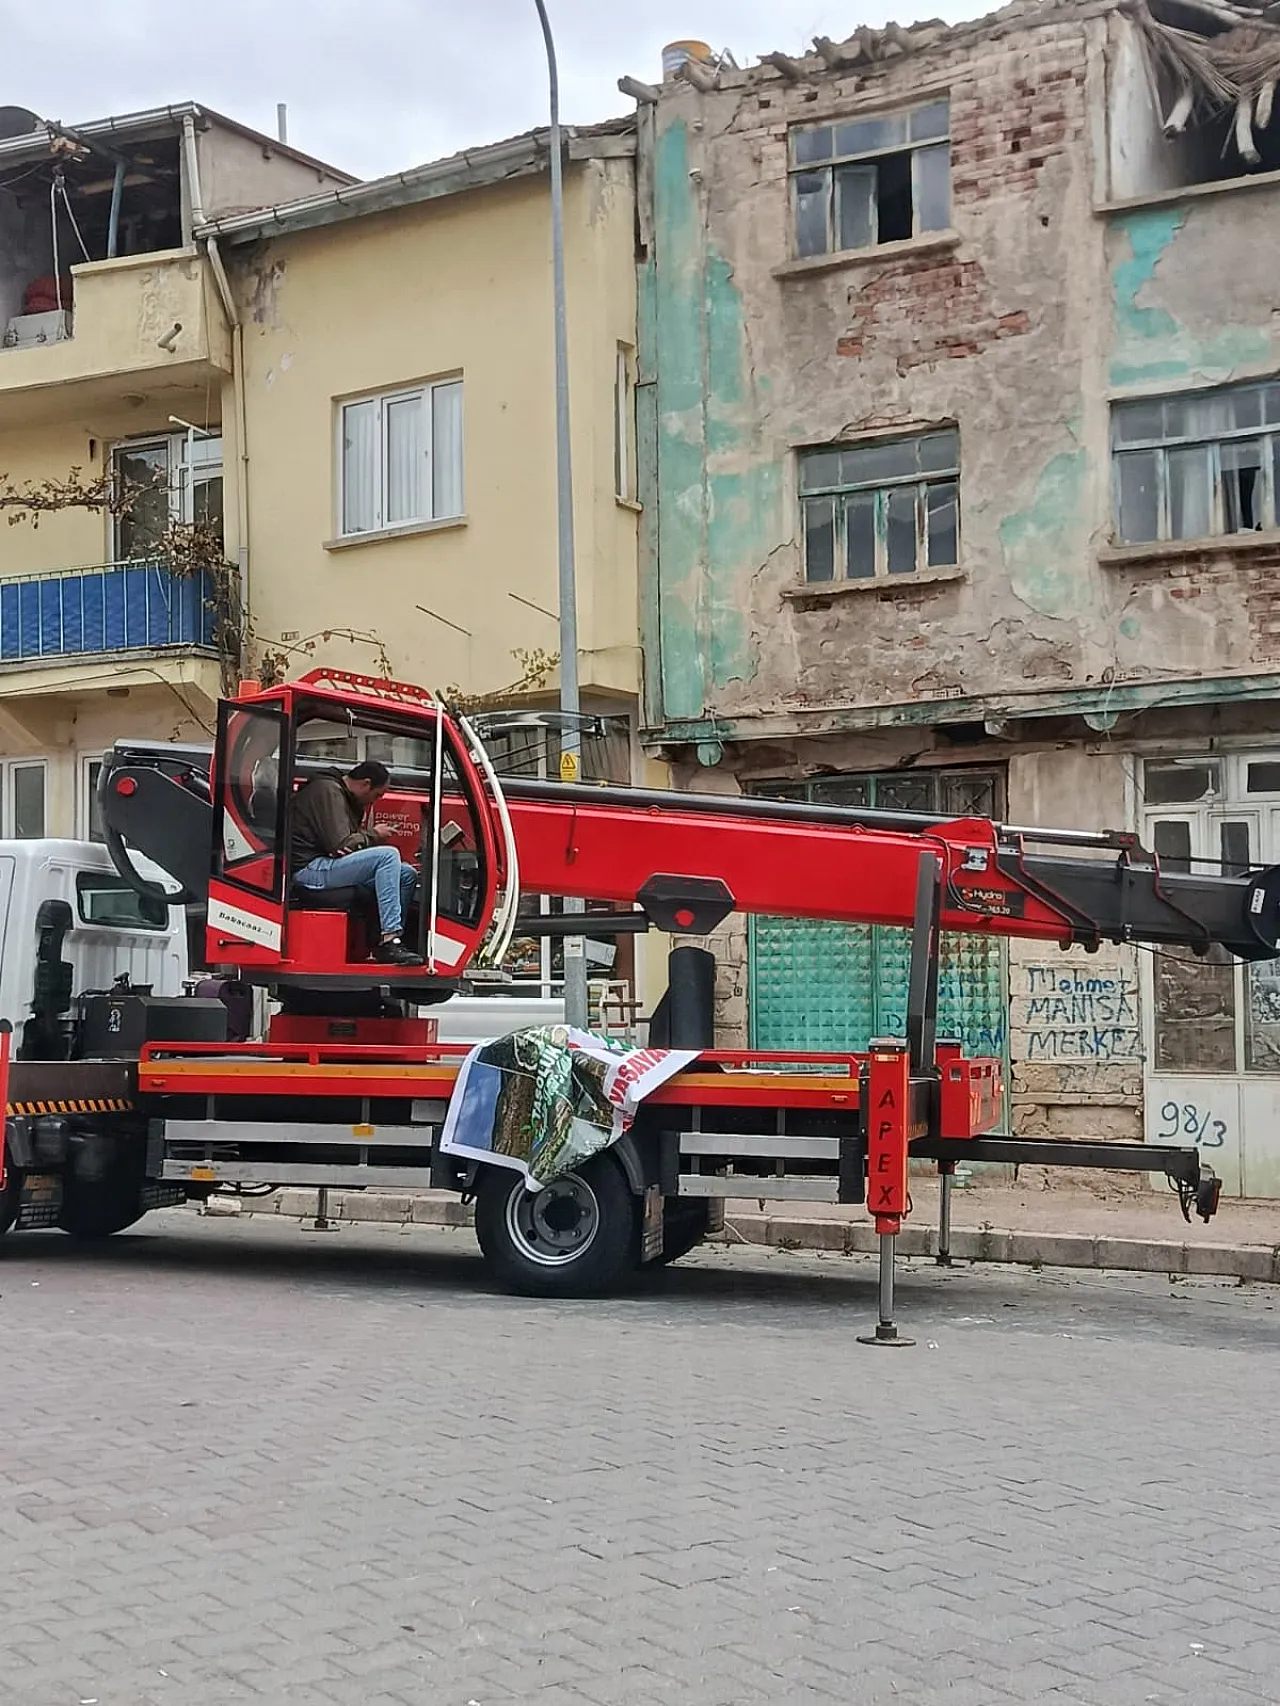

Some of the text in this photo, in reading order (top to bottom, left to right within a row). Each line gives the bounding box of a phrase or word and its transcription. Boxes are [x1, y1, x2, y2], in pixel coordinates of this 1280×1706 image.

[974, 889, 1003, 900] Hydro
[1028, 967, 1132, 995] Mehmet
[1158, 1101, 1227, 1147] 98/3
[877, 1088, 896, 1206] APEX
